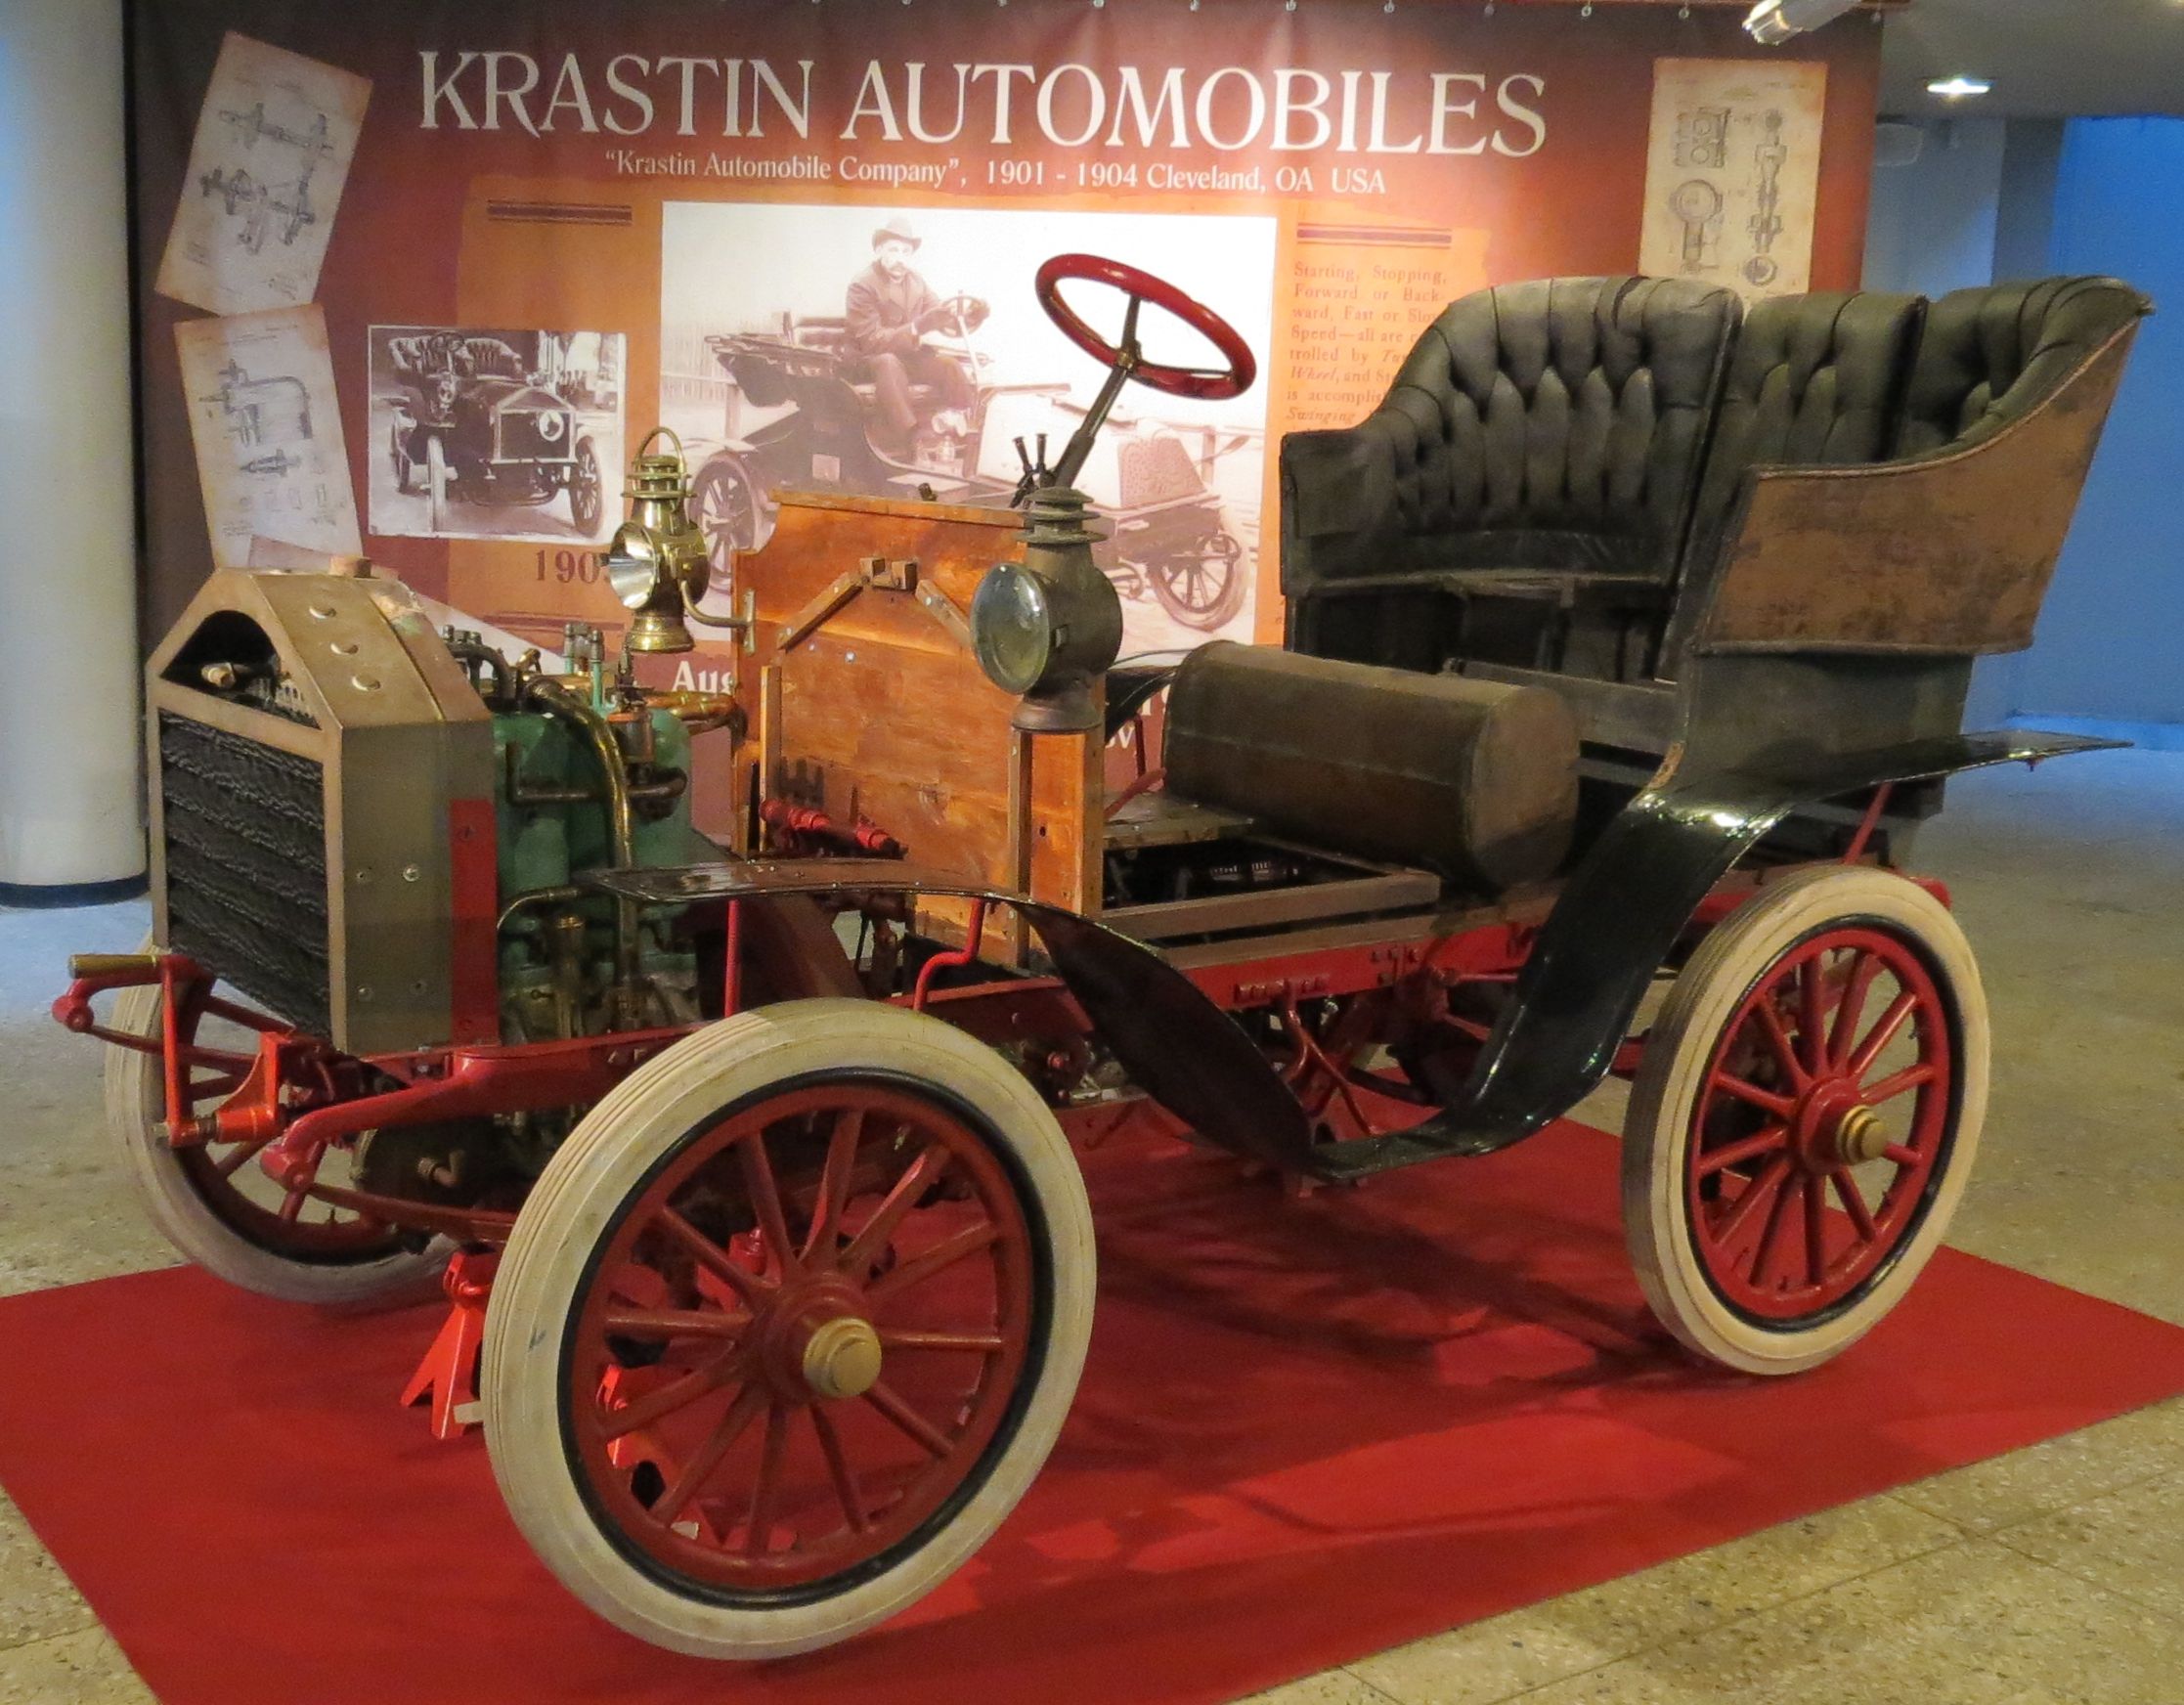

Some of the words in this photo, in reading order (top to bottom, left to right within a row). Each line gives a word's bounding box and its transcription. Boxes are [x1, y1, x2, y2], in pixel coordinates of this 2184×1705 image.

[419, 51, 812, 139] KRASTIN
[840, 60, 1547, 157] AUTOMOBILES
[703, 152, 831, 180] Automobile
[988, 160, 1043, 186] 1901
[1078, 162, 1138, 188] 1904
[1147, 163, 1266, 194] Cleveland,
[1275, 166, 1314, 192] OA
[1332, 168, 1385, 194] USA
[1294, 261, 1360, 284] Starting,
[1373, 265, 1447, 285] Stopping,
[1294, 283, 1358, 300] Forward
[1373, 290, 1389, 300] or
[1292, 305, 1334, 322] ward,
[1343, 305, 1374, 321] Fast
[1382, 312, 1399, 322] or
[1380, 331, 1403, 342] are
[1289, 347, 1338, 361] trolled
[1351, 347, 1369, 364] by
[1290, 365, 1339, 384] Wheel,
[1344, 369, 1370, 382] and
[1287, 390, 1298, 401] is
[1287, 407, 1356, 424] Swinging
[537, 549, 608, 584] 190
